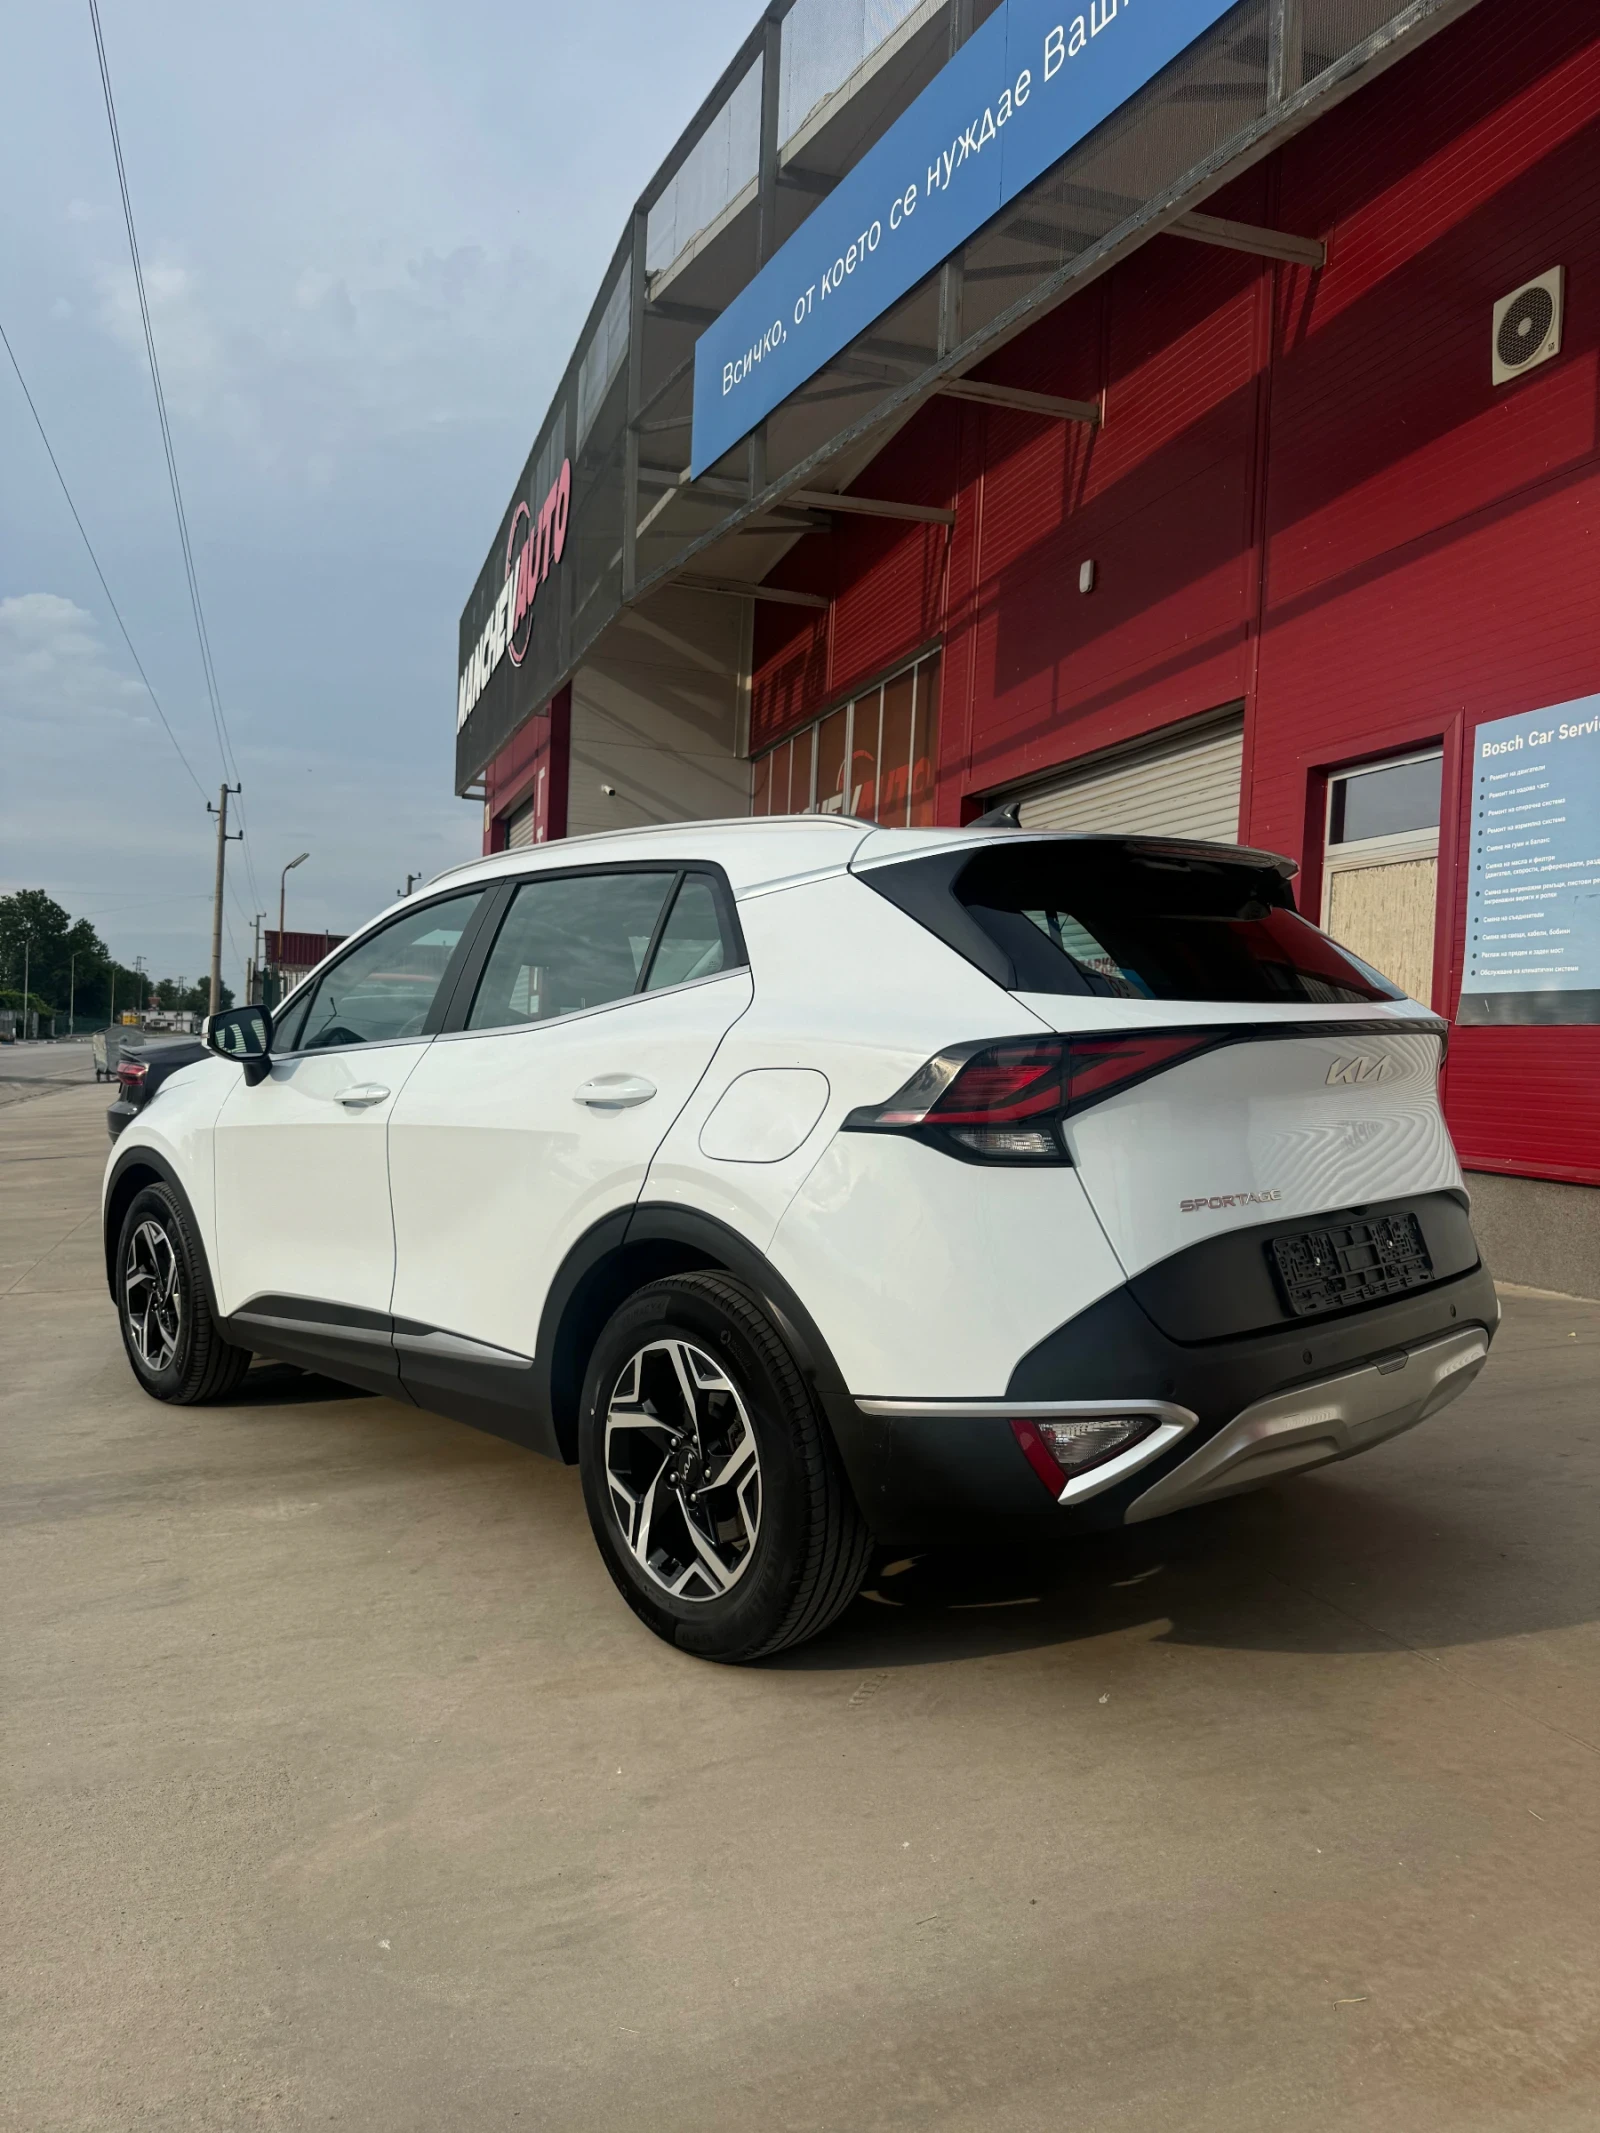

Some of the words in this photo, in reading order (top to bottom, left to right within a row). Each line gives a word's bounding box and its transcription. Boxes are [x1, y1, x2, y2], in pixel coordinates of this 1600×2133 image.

[722, 320, 787, 396] Всичко,
[794, 284, 815, 324] от
[821, 221, 881, 302] което
[890, 184, 916, 231] се
[926, 69, 1031, 195] нуждае
[1044, 0, 1129, 82] Ваш
[457, 554, 521, 735] MANCHEV
[514, 458, 570, 633] AUTO
[1482, 735, 1523, 757] Bosch
[1528, 730, 1554, 747] Car
[1559, 715, 1600, 740] Servi
[1180, 1190, 1282, 1213] SPORTAGE
